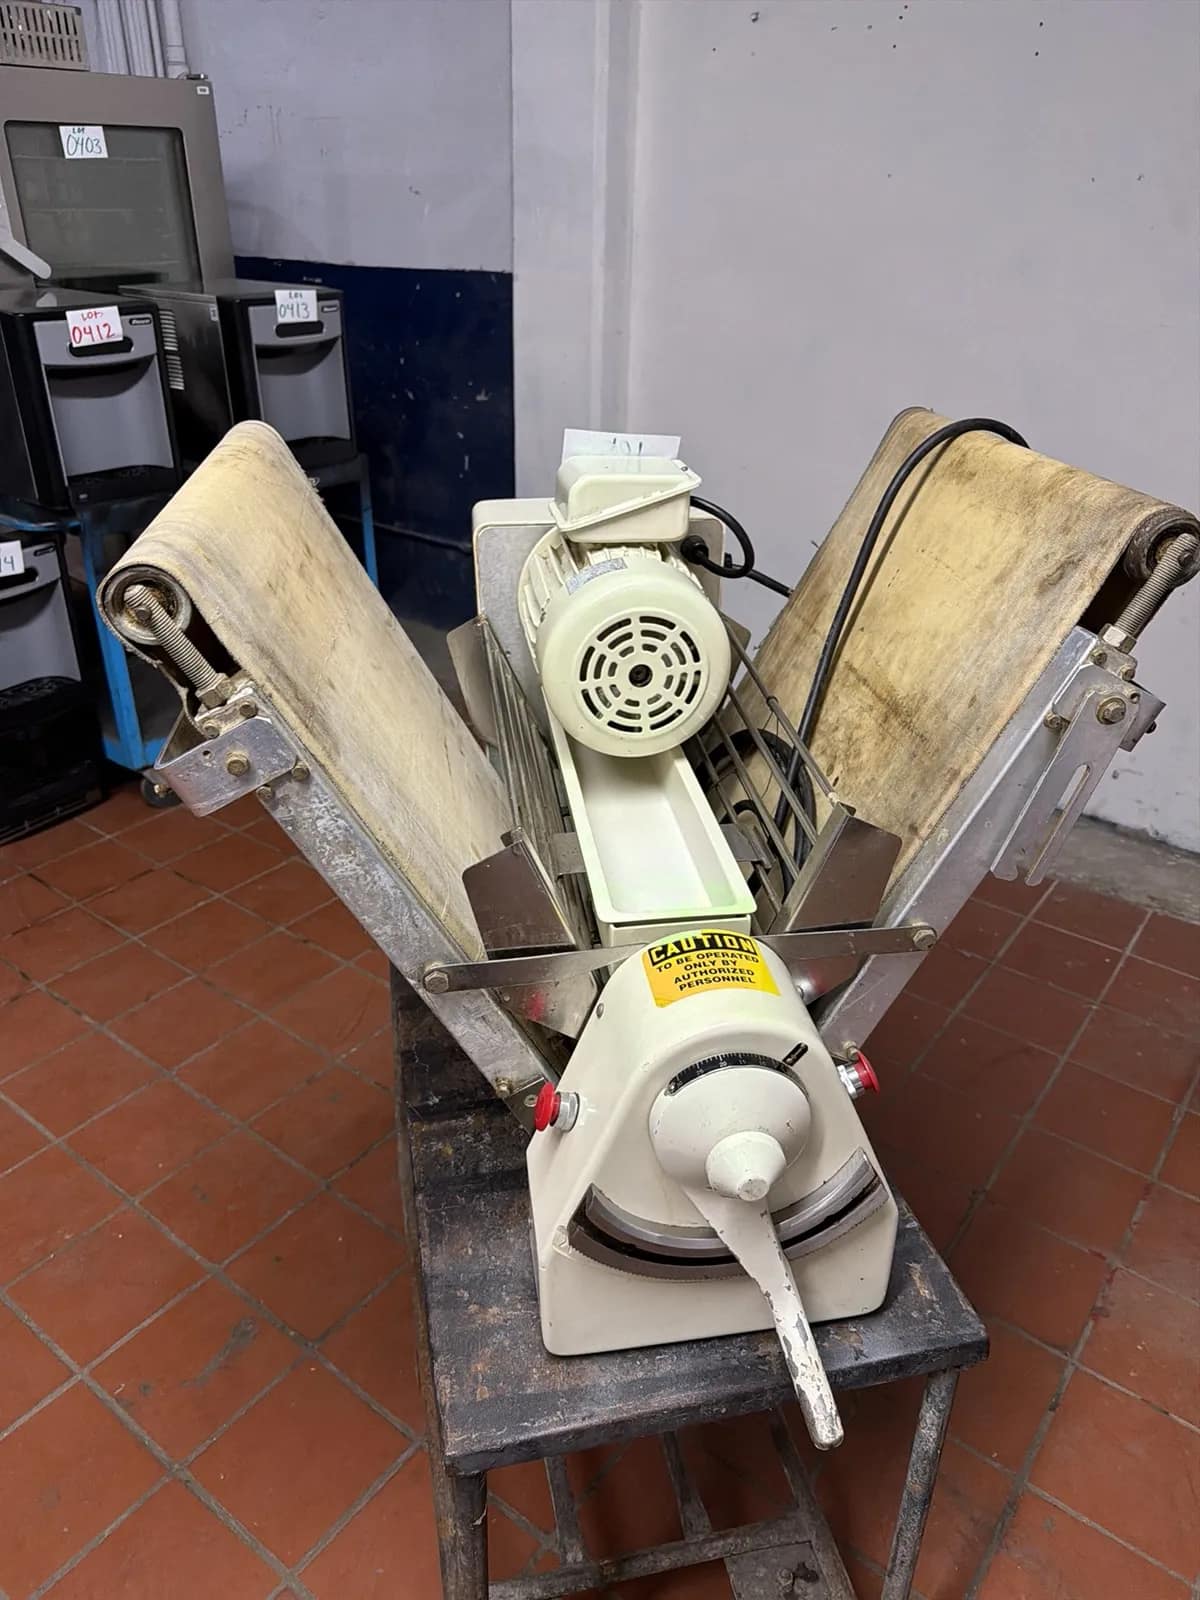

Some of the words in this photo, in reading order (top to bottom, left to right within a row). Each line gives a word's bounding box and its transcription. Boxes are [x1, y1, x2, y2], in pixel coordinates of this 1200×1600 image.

[66, 134, 102, 156] 0403
[279, 302, 310, 319] 0413
[72, 323, 116, 344] 0412
[650, 935, 755, 963] CAUTION
[656, 962, 672, 972] TO
[676, 955, 693, 965] BE
[696, 951, 759, 963] OPERATED
[684, 959, 717, 972] ONLY
[722, 959, 737, 967] BY
[674, 968, 755, 984] AUTHORIZED
[679, 976, 756, 991] PERSONNEL
